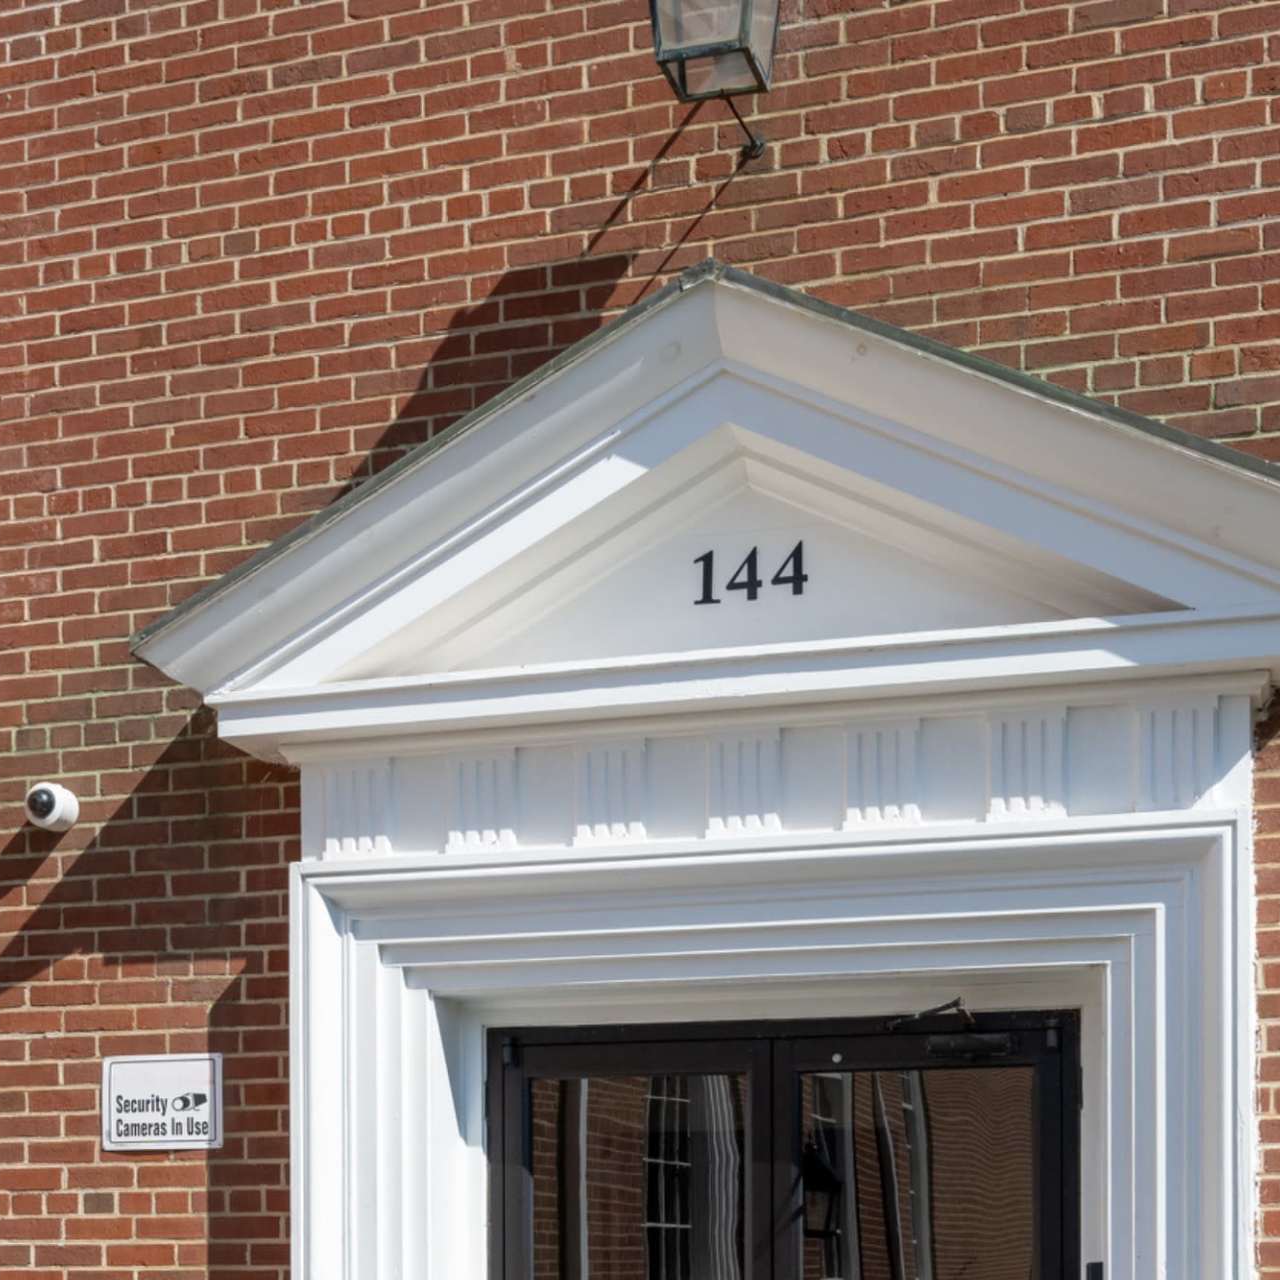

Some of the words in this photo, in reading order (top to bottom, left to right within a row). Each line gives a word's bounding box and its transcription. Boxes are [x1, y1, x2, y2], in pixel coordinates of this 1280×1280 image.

[693, 539, 808, 605] 144
[115, 1093, 168, 1117] Security
[115, 1117, 168, 1137] Cameras
[171, 1117, 183, 1136] In
[186, 1116, 209, 1136] Use
